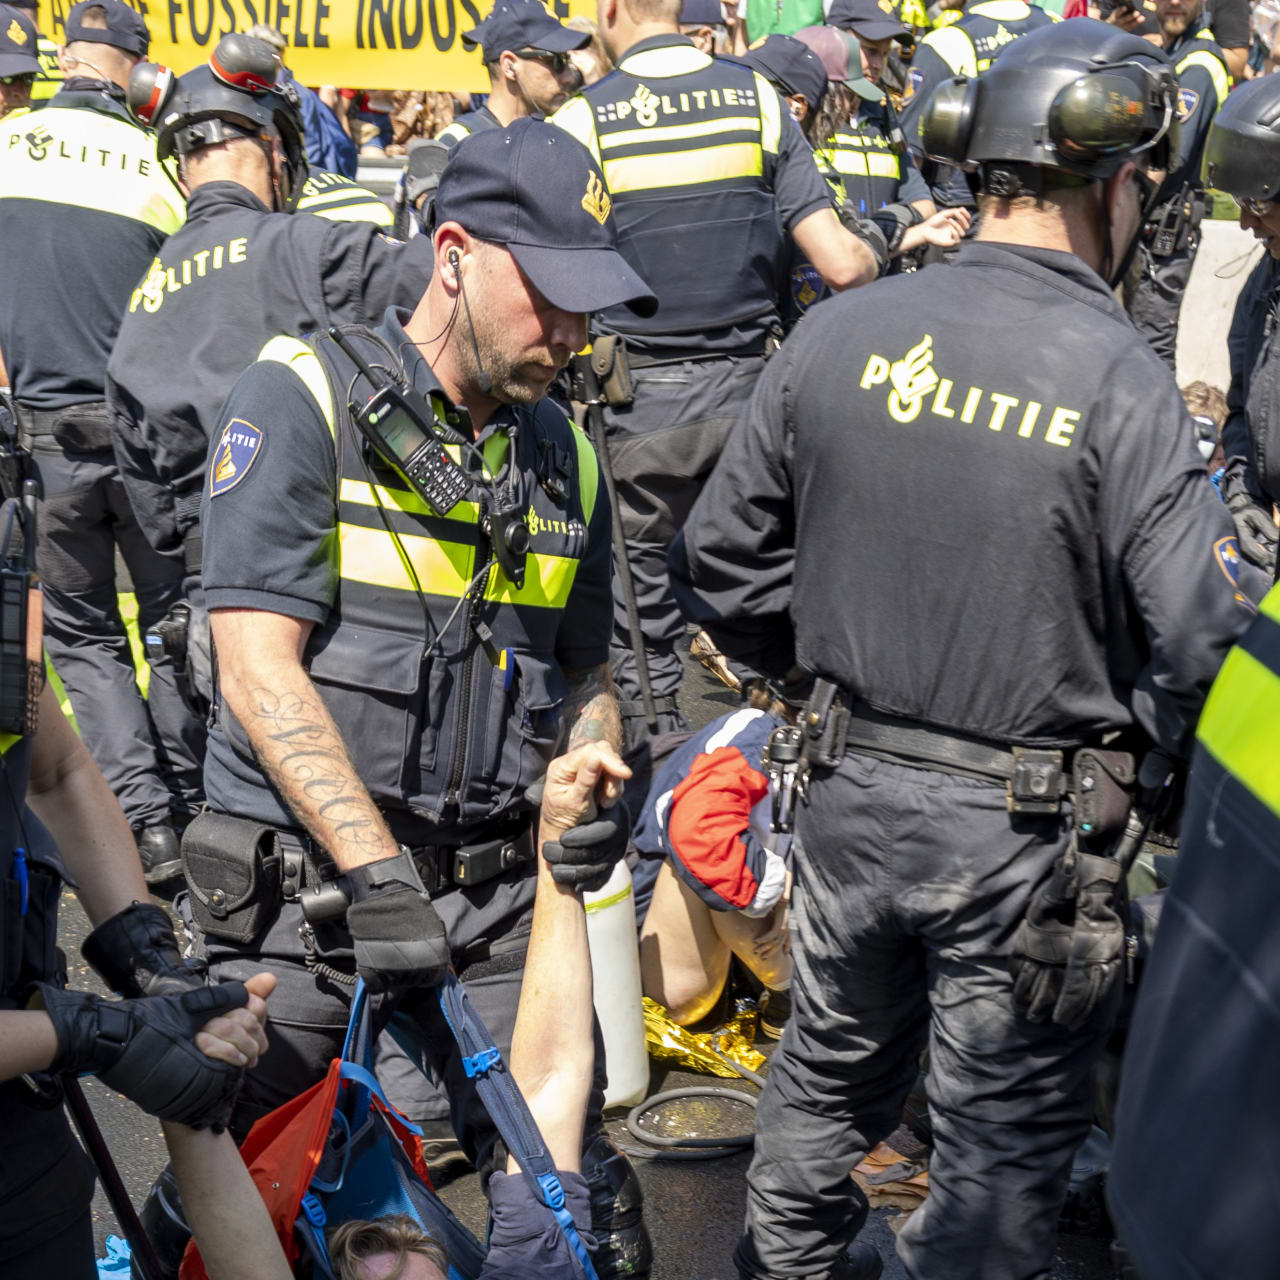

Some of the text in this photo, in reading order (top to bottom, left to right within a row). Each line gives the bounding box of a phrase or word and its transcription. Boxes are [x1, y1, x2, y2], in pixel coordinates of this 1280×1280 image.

[616, 83, 739, 127] POLITIE
[9, 125, 151, 177] POLITIE
[128, 237, 248, 313] POLITIE
[859, 334, 1082, 447] POLITIE
